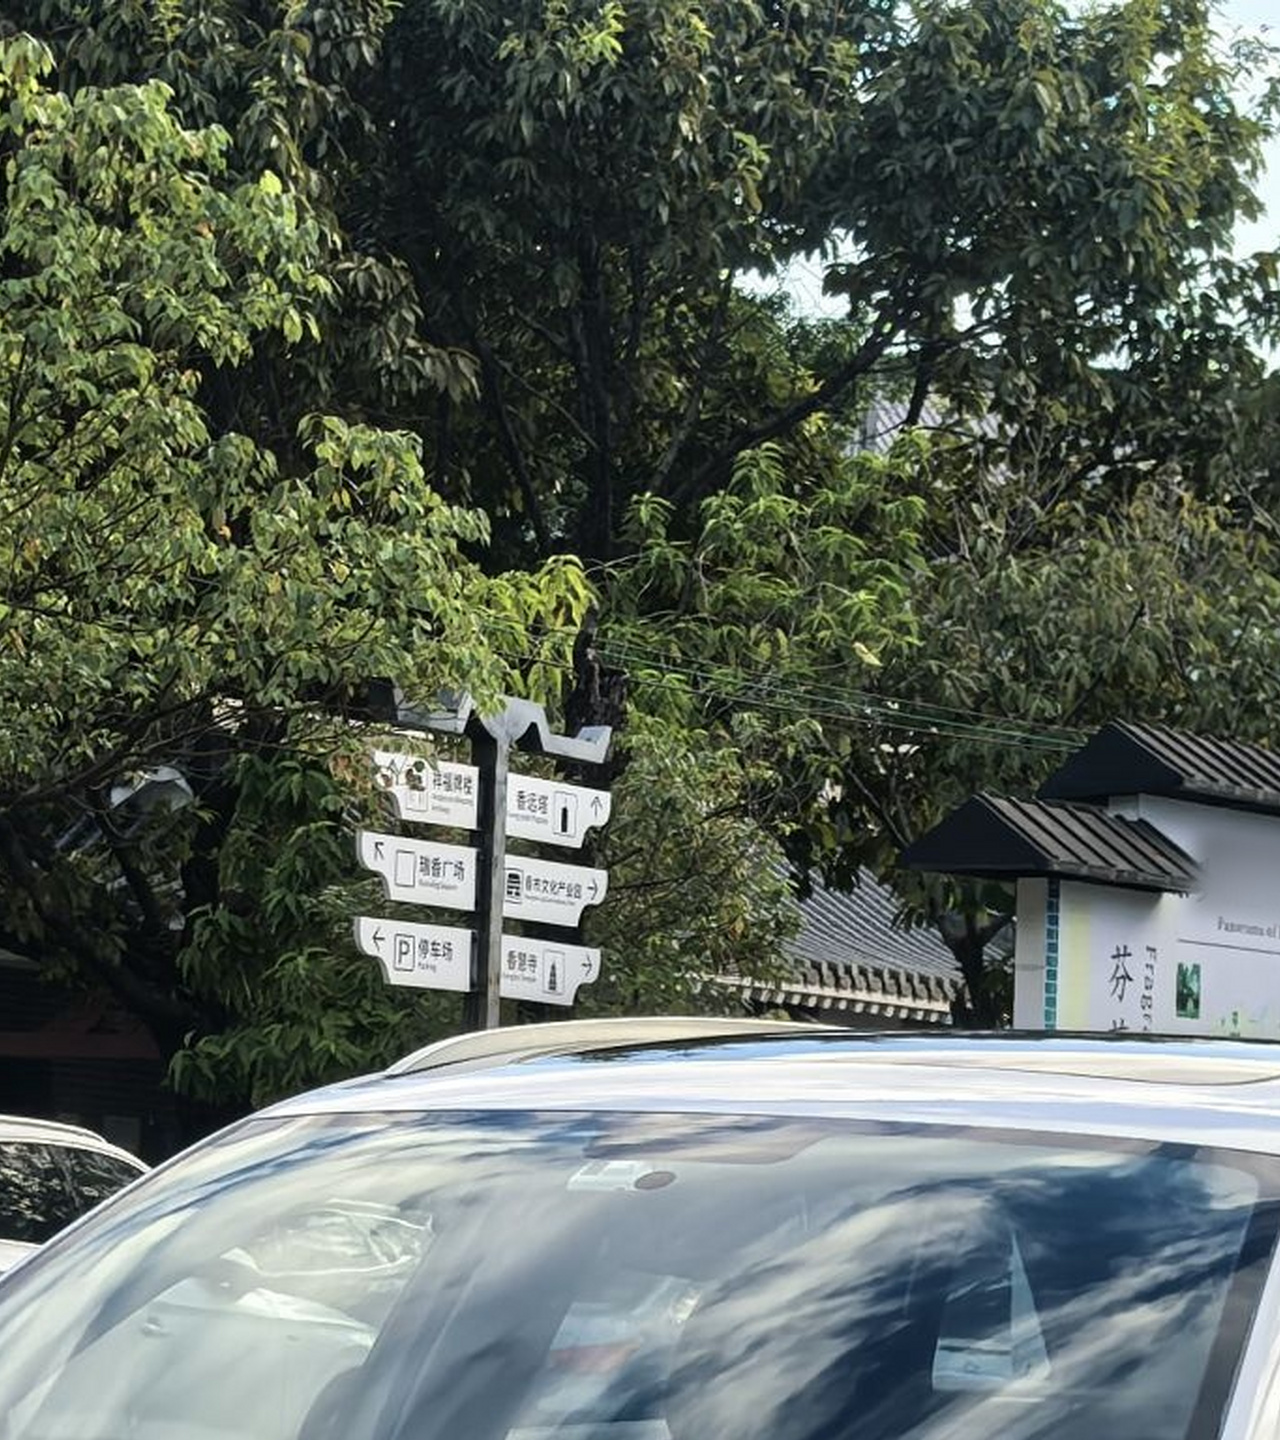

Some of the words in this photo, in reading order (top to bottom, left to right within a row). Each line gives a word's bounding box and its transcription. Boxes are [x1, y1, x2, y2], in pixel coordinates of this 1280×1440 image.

[418, 938, 454, 962] 停车场
[1139, 945, 1158, 1032] Fragr
